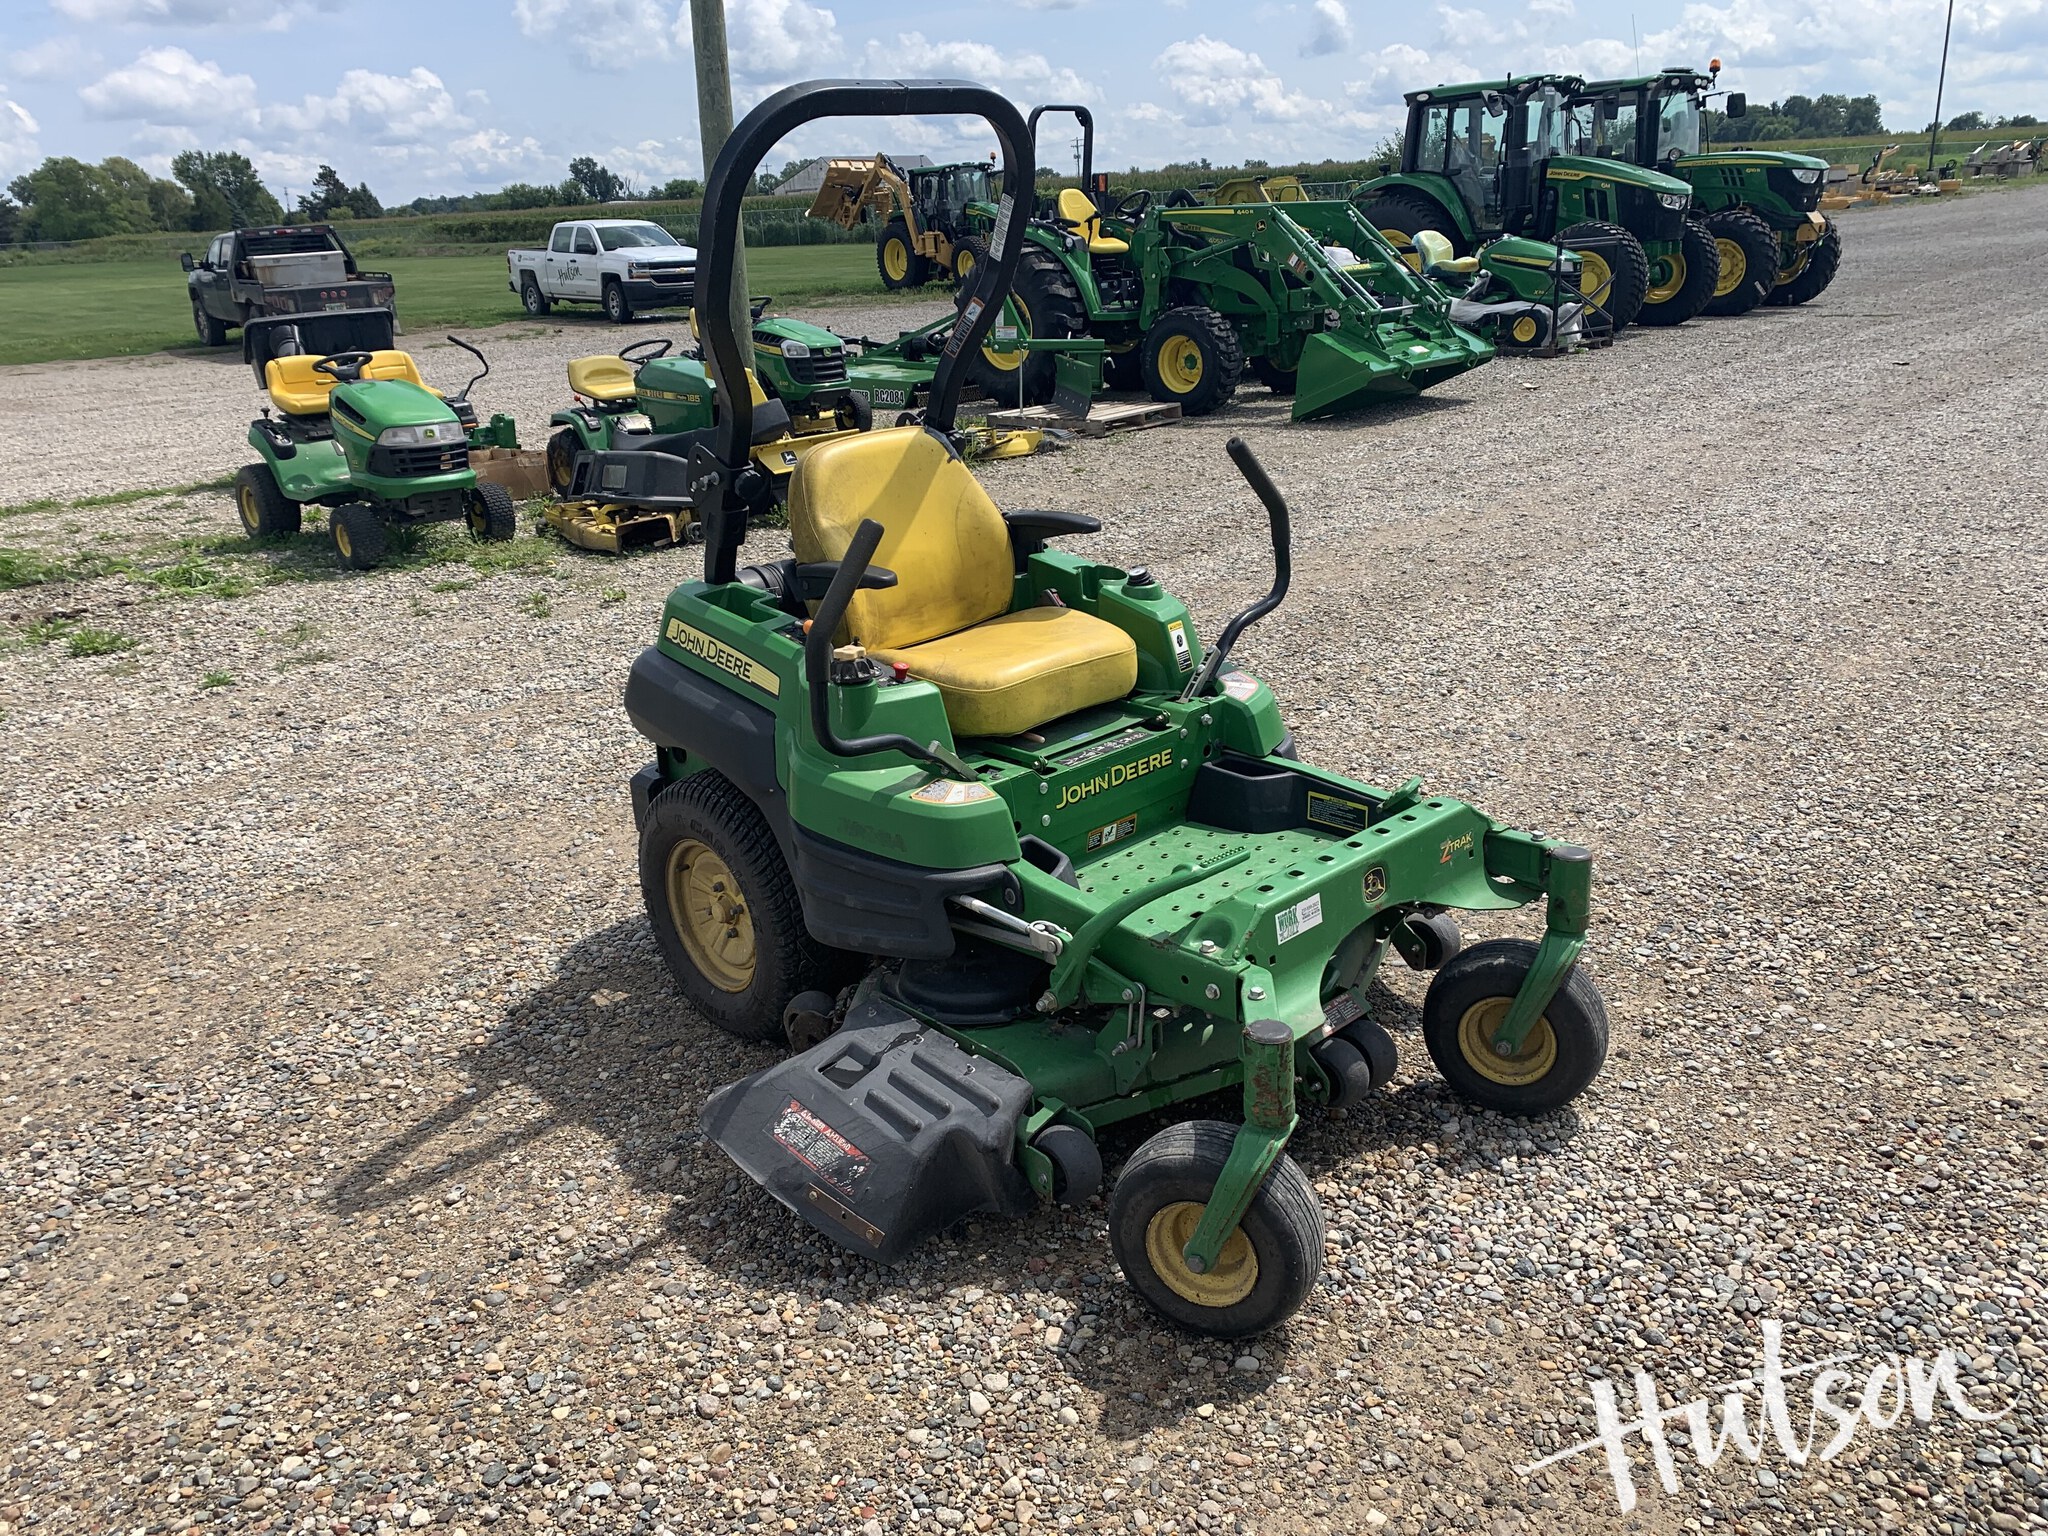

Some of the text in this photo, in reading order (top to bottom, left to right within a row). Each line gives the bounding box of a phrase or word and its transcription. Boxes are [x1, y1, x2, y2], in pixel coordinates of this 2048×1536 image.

[556, 261, 583, 288] Hutson
[686, 394, 701, 403] 185
[874, 388, 906, 405] RC2084
[671, 623, 753, 680] JOHN DEERE
[1056, 773, 1109, 810] JOHN
[1111, 748, 1173, 788] DEERE
